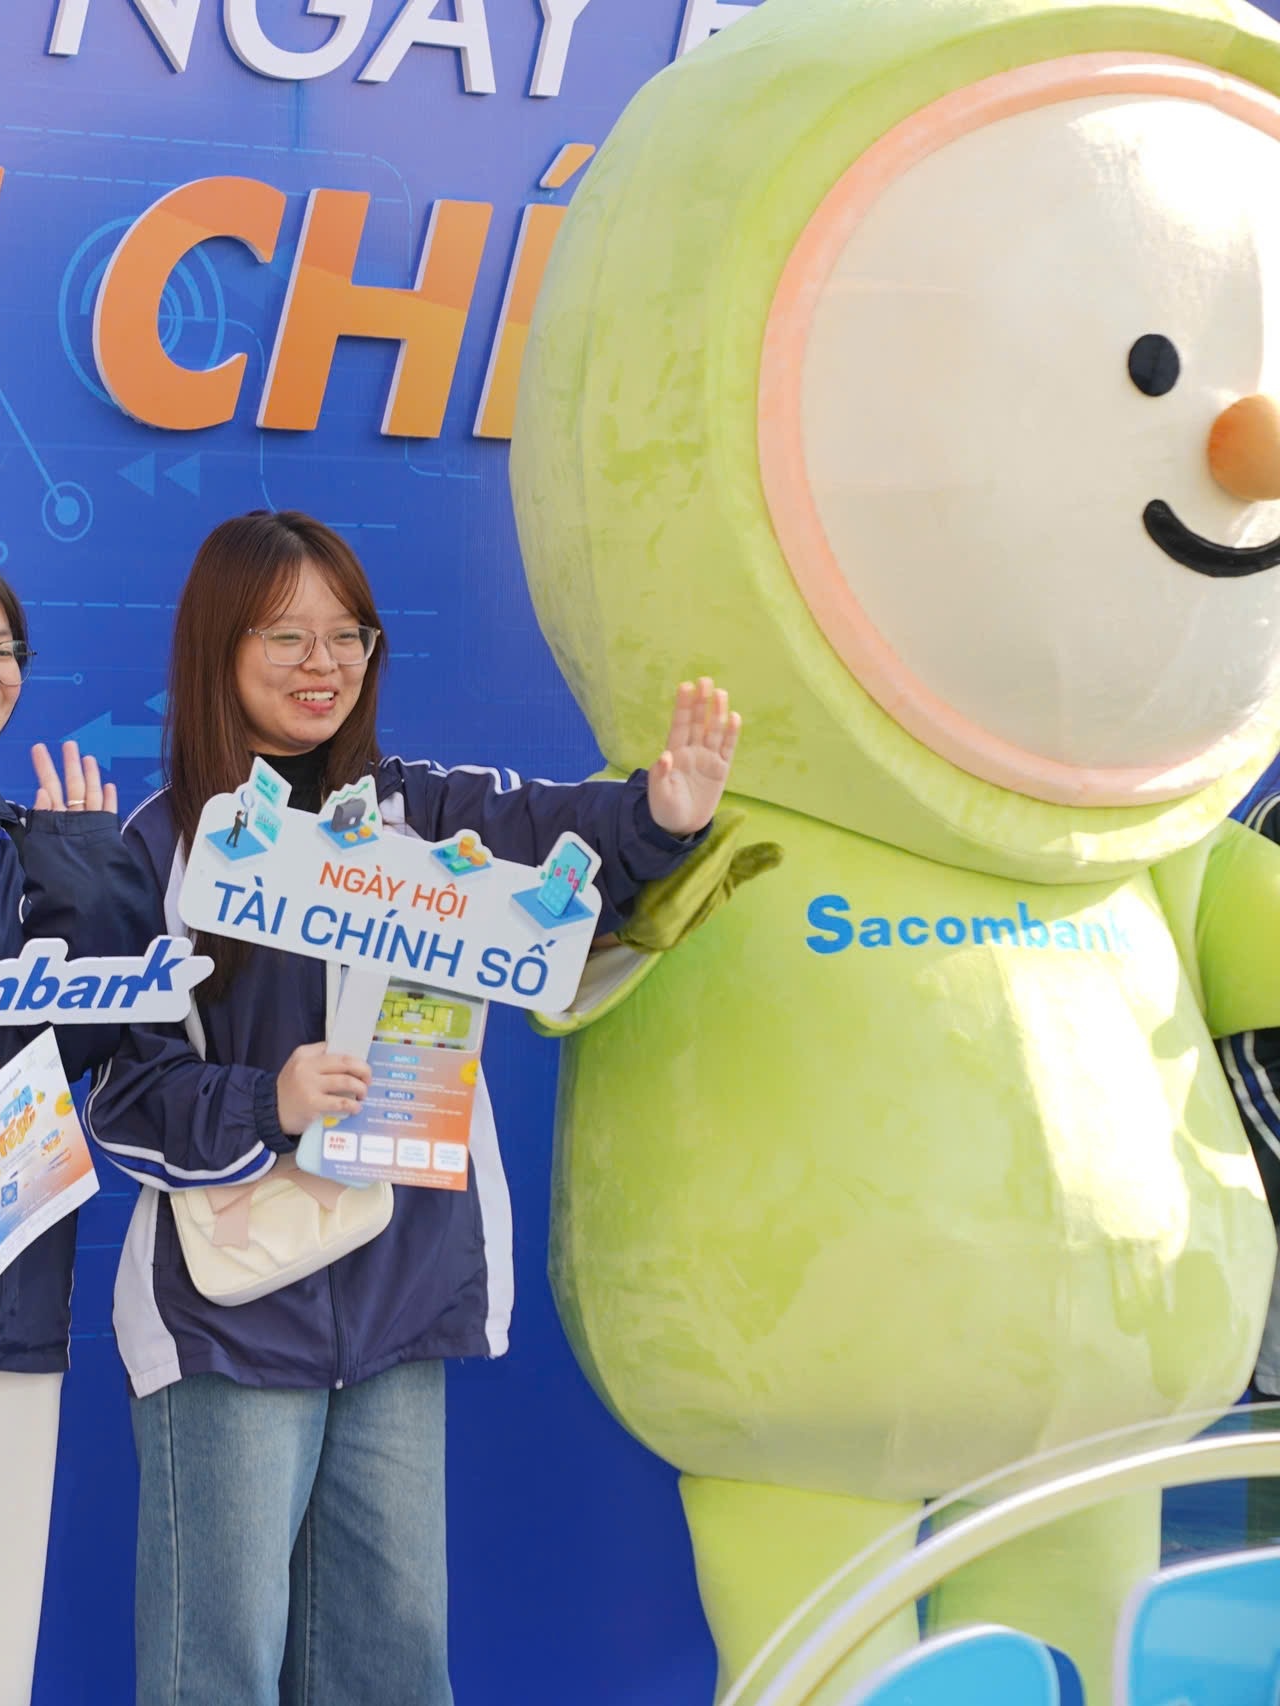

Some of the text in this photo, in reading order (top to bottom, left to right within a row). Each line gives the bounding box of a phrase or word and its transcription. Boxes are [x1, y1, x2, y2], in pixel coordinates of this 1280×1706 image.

[319, 861, 468, 924] NGÀY HỘI
[214, 876, 556, 997] TÀI CHÍNH SỐ
[805, 894, 1134, 955] Sacombank
